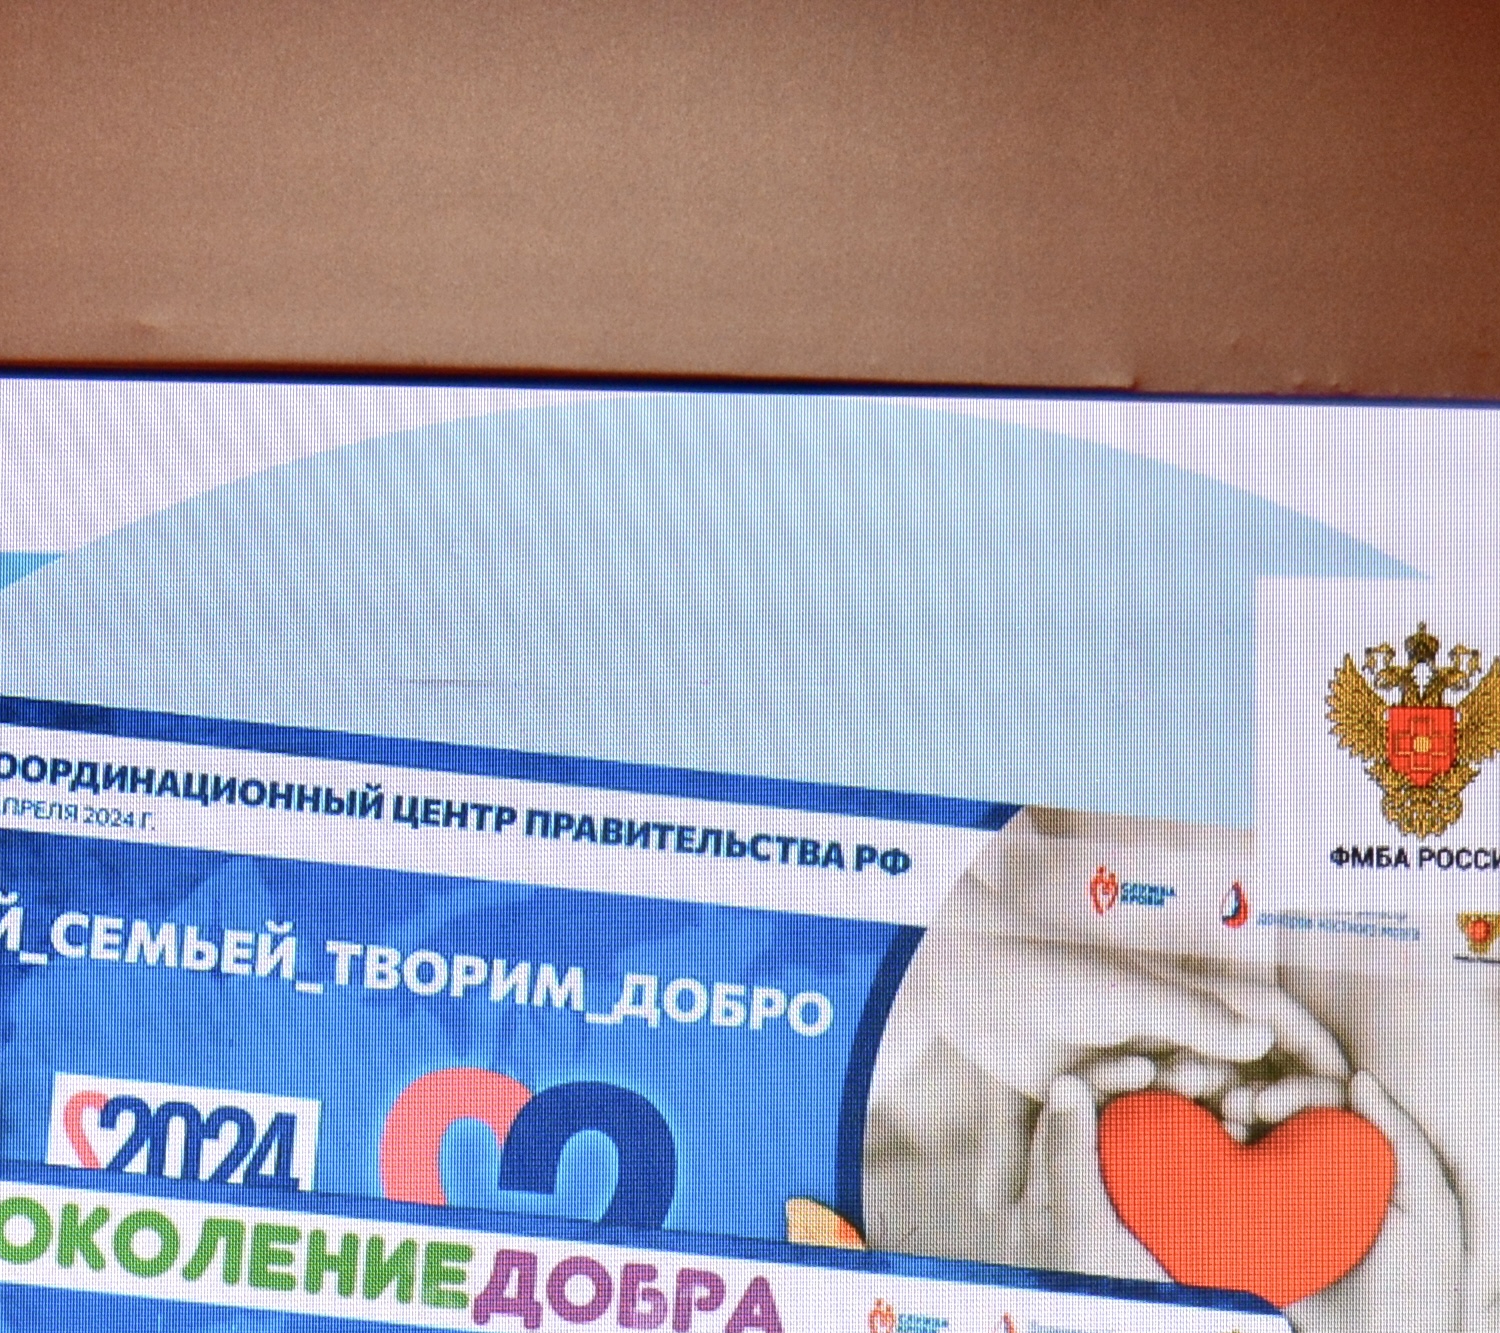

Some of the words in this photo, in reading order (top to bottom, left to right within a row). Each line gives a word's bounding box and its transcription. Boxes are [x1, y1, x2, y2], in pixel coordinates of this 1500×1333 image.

[82, 805, 136, 830] 2024
[392, 792, 518, 833] ЦЕНТР
[526, 808, 845, 871] ПРАВИТЕЛЬСТВА
[854, 841, 912, 877] РФ
[1329, 844, 1410, 871] ФМБА
